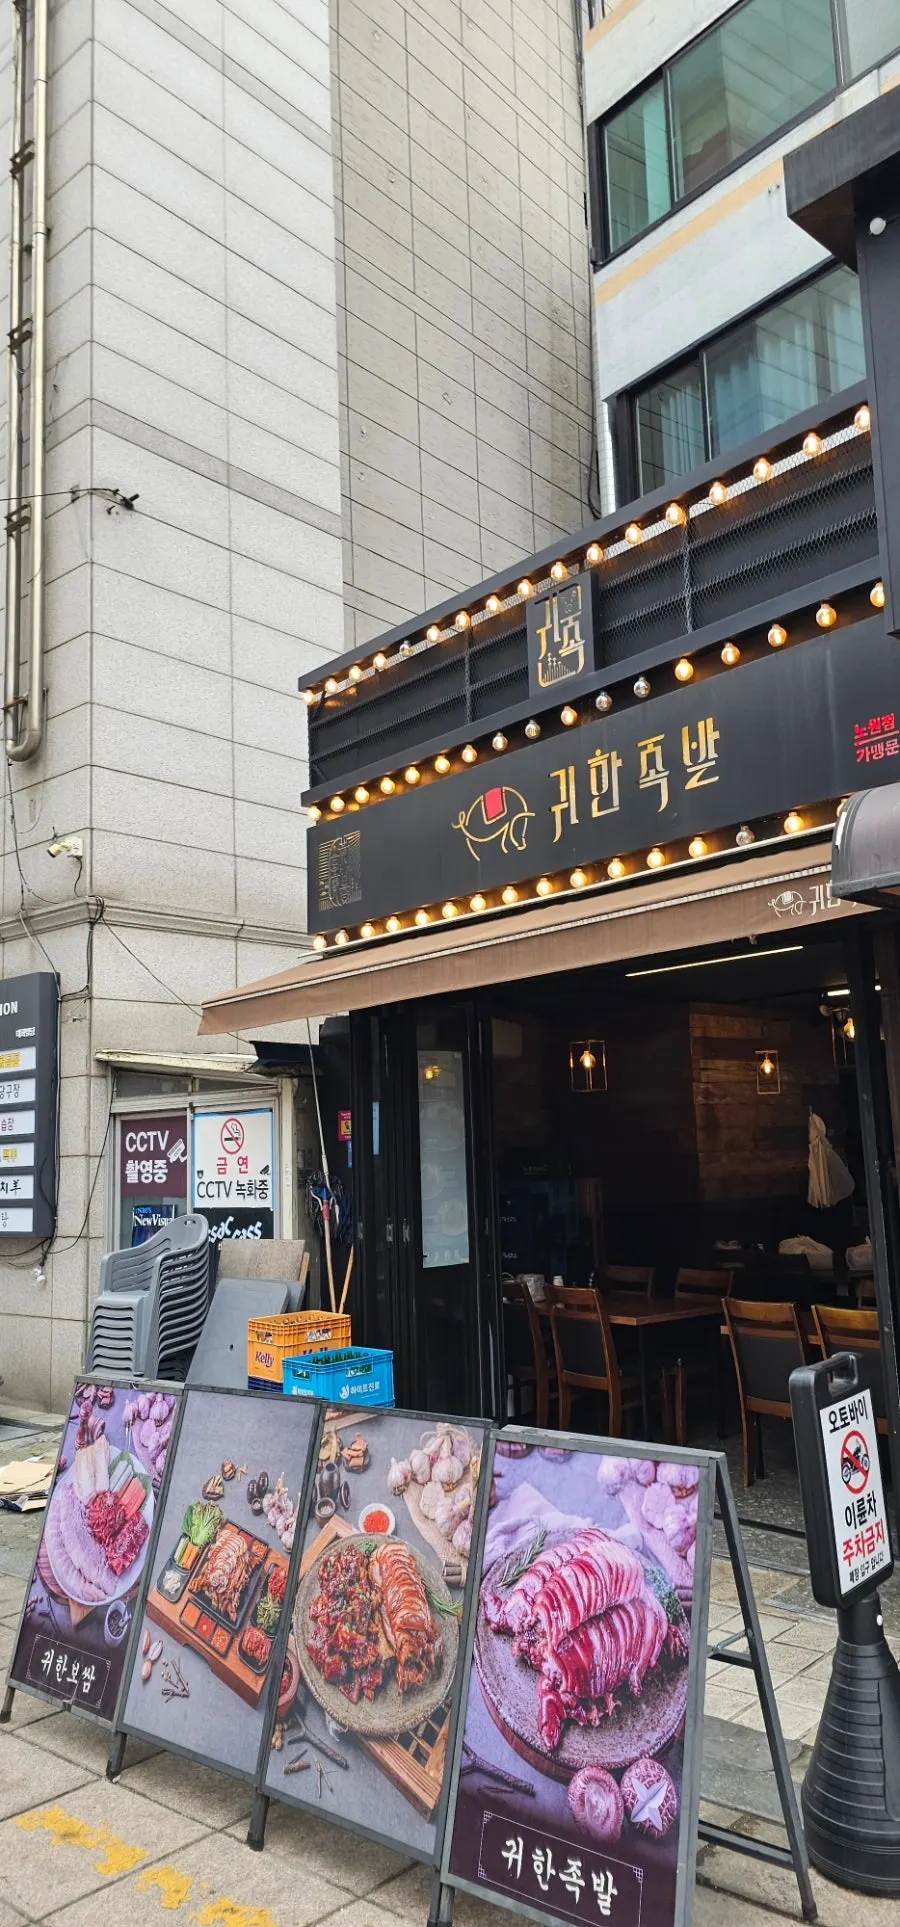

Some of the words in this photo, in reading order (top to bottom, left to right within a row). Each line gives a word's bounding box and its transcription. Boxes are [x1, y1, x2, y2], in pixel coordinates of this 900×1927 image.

[854, 712, 895, 739] 노원점
[125, 1130, 169, 1152] CCTV
[125, 1159, 168, 1184] 촬영중
[196, 1180, 233, 1198] CCTV
[235, 1179, 269, 1200] 녹화중
[255, 1351, 274, 1367] Kelly
[829, 1396, 868, 1433] 오토바이
[845, 1490, 877, 1530] 이륜차
[843, 1518, 886, 1567] 주차금지
[501, 1836, 618, 1916] 귀한족발
